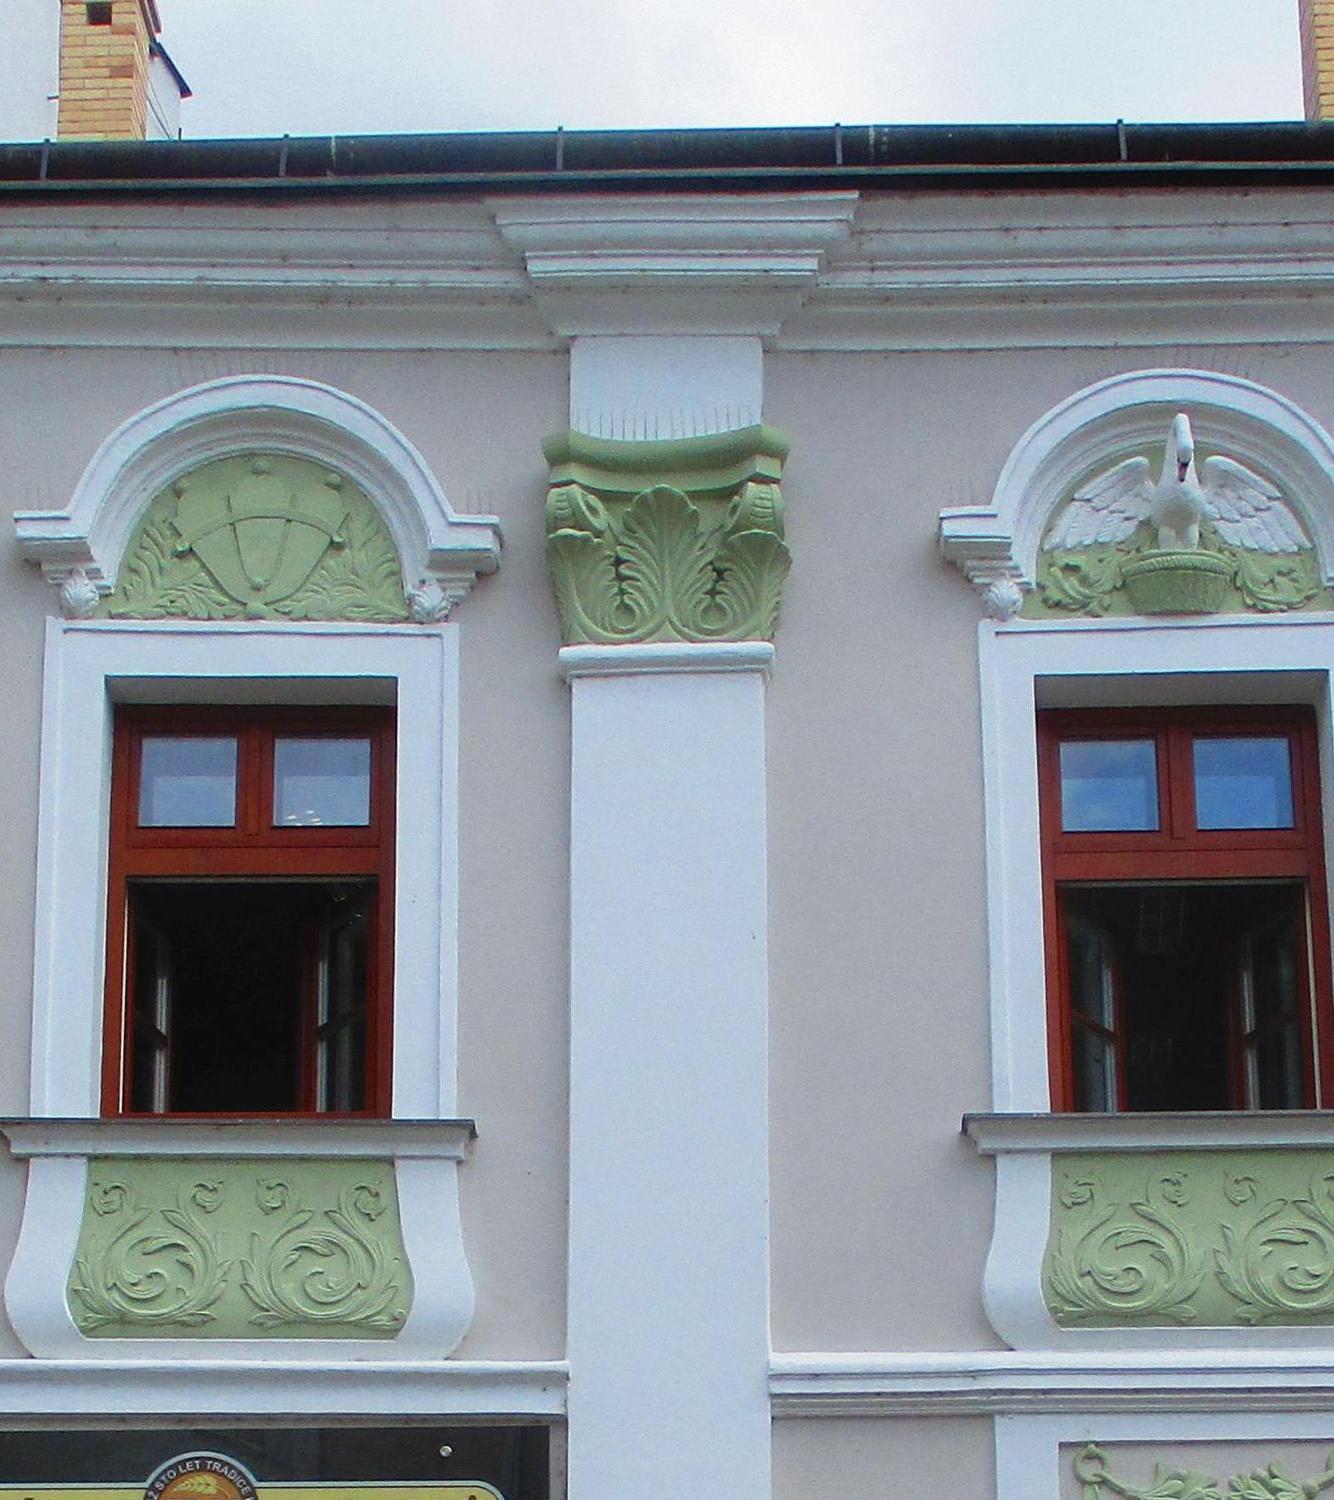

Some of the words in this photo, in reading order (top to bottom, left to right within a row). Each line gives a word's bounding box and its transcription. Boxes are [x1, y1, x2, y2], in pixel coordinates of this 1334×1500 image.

[155, 1469, 176, 1490] STO
[178, 1460, 201, 1473] LET
[206, 1460, 251, 1495] TRADICE
